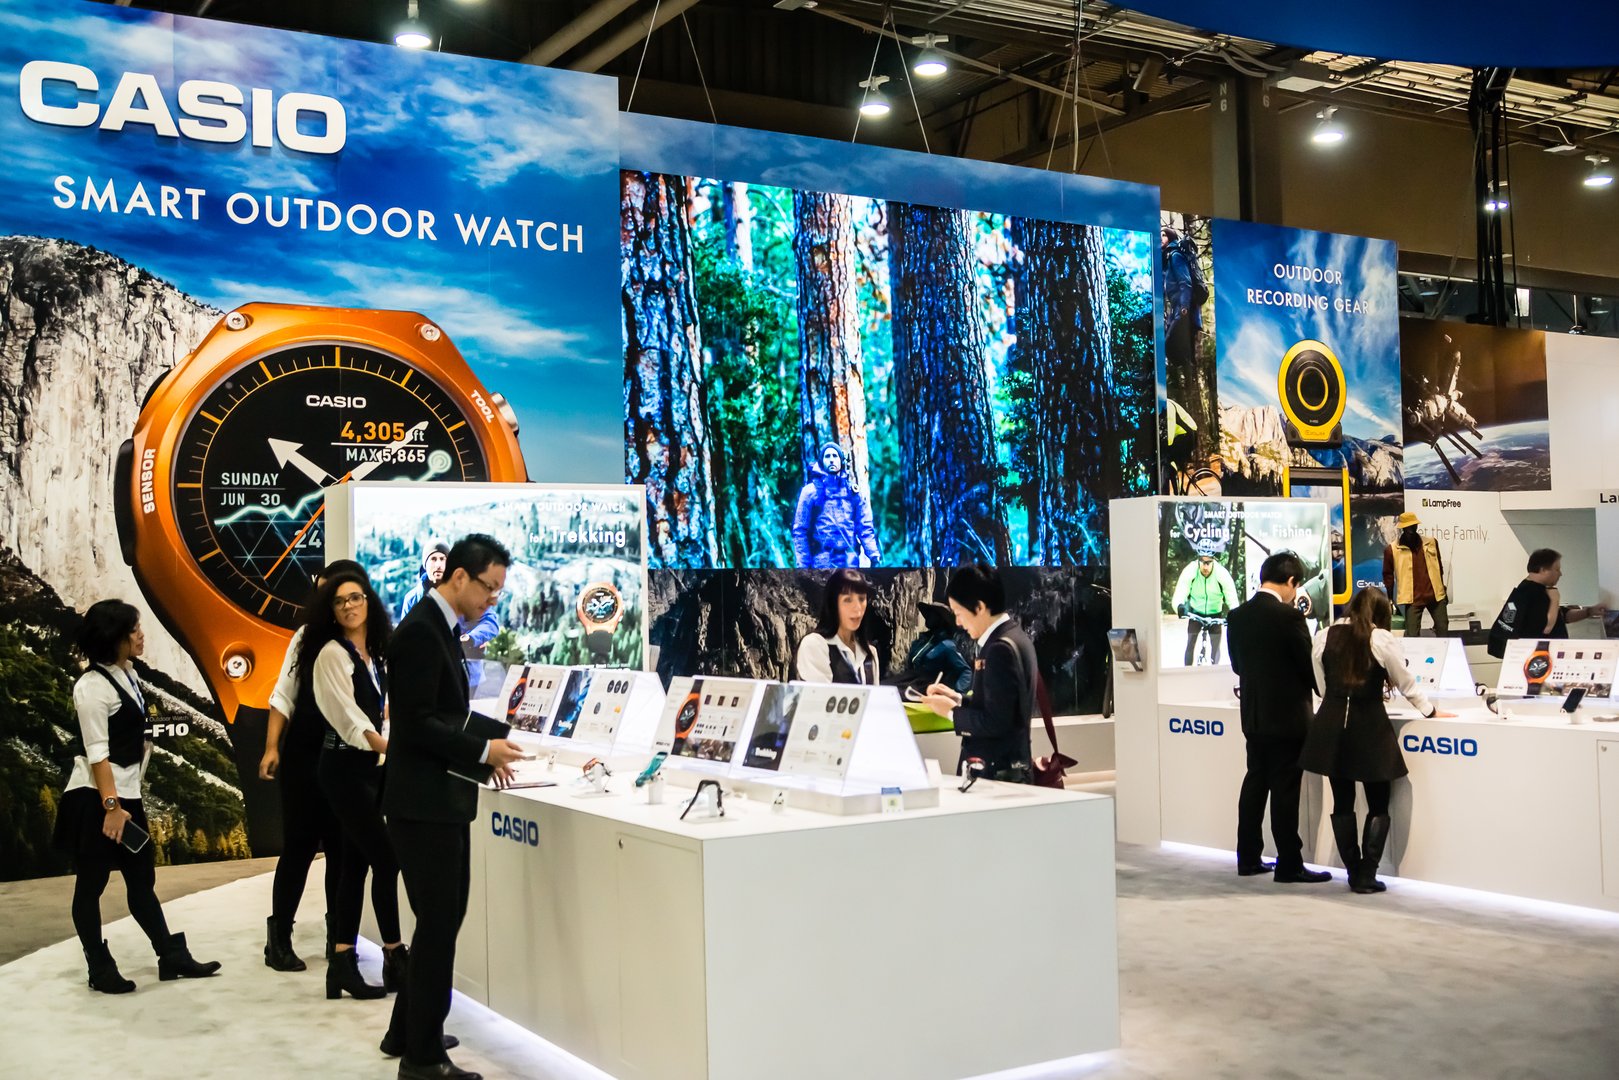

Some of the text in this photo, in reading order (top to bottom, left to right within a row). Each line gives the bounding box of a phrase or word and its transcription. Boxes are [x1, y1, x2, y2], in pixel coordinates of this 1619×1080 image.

[19, 60, 347, 155] CASIO
[53, 174, 584, 254] SMART OUTDOOR WATCH
[1273, 263, 1343, 285] OUTDOOR
[1247, 288, 1369, 314] RECORDING GEAR
[305, 394, 367, 409] CASIO
[470, 390, 495, 424] TOOL
[340, 421, 425, 443] 4,305 ft
[346, 447, 426, 465] MAX 5,865
[140, 448, 156, 515] SENSOR
[221, 472, 279, 486] SUNDAY
[220, 492, 281, 506] JUN 30
[537, 502, 588, 512] OUTDOOR
[592, 502, 626, 512] WATCH
[1428, 498, 1462, 509] LampFree
[1600, 492, 1619, 503] La
[1204, 510, 1226, 519] SMART
[529, 524, 626, 548] for Trekking
[1169, 523, 1230, 542] for Cycling
[1272, 523, 1312, 540] Fishing
[1431, 524, 1450, 540] the
[144, 723, 189, 737] -F10
[1169, 717, 1224, 736] CASIO
[1403, 734, 1478, 757] CASIO
[491, 811, 539, 847] CASIO
